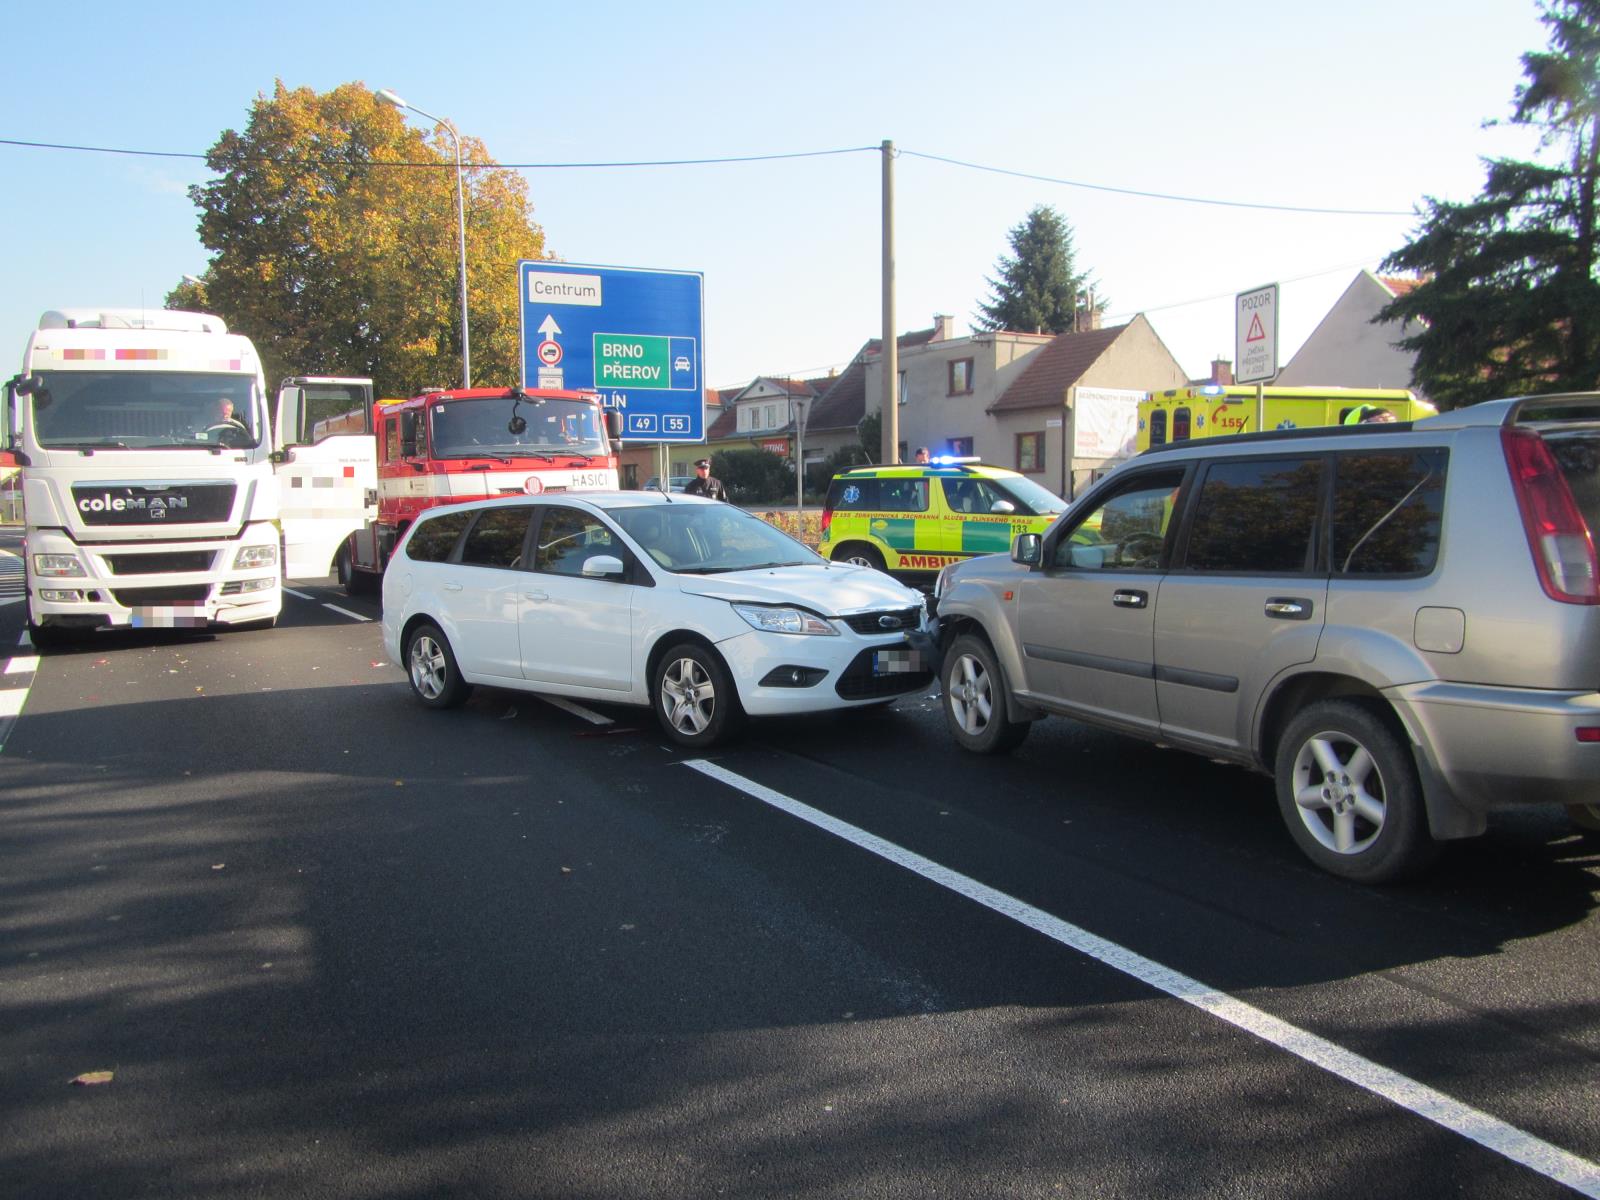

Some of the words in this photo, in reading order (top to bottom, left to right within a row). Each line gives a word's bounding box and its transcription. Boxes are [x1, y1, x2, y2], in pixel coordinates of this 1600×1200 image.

[534, 280, 596, 297] Centrum
[1242, 292, 1271, 312] POZOR
[602, 343, 643, 358] BRNO
[603, 361, 661, 380] PŘEROV
[636, 418, 651, 430] 49
[669, 419, 684, 430] 55
[1222, 418, 1243, 428] 155
[1012, 525, 1028, 534] 133
[899, 555, 959, 569] AMBU
